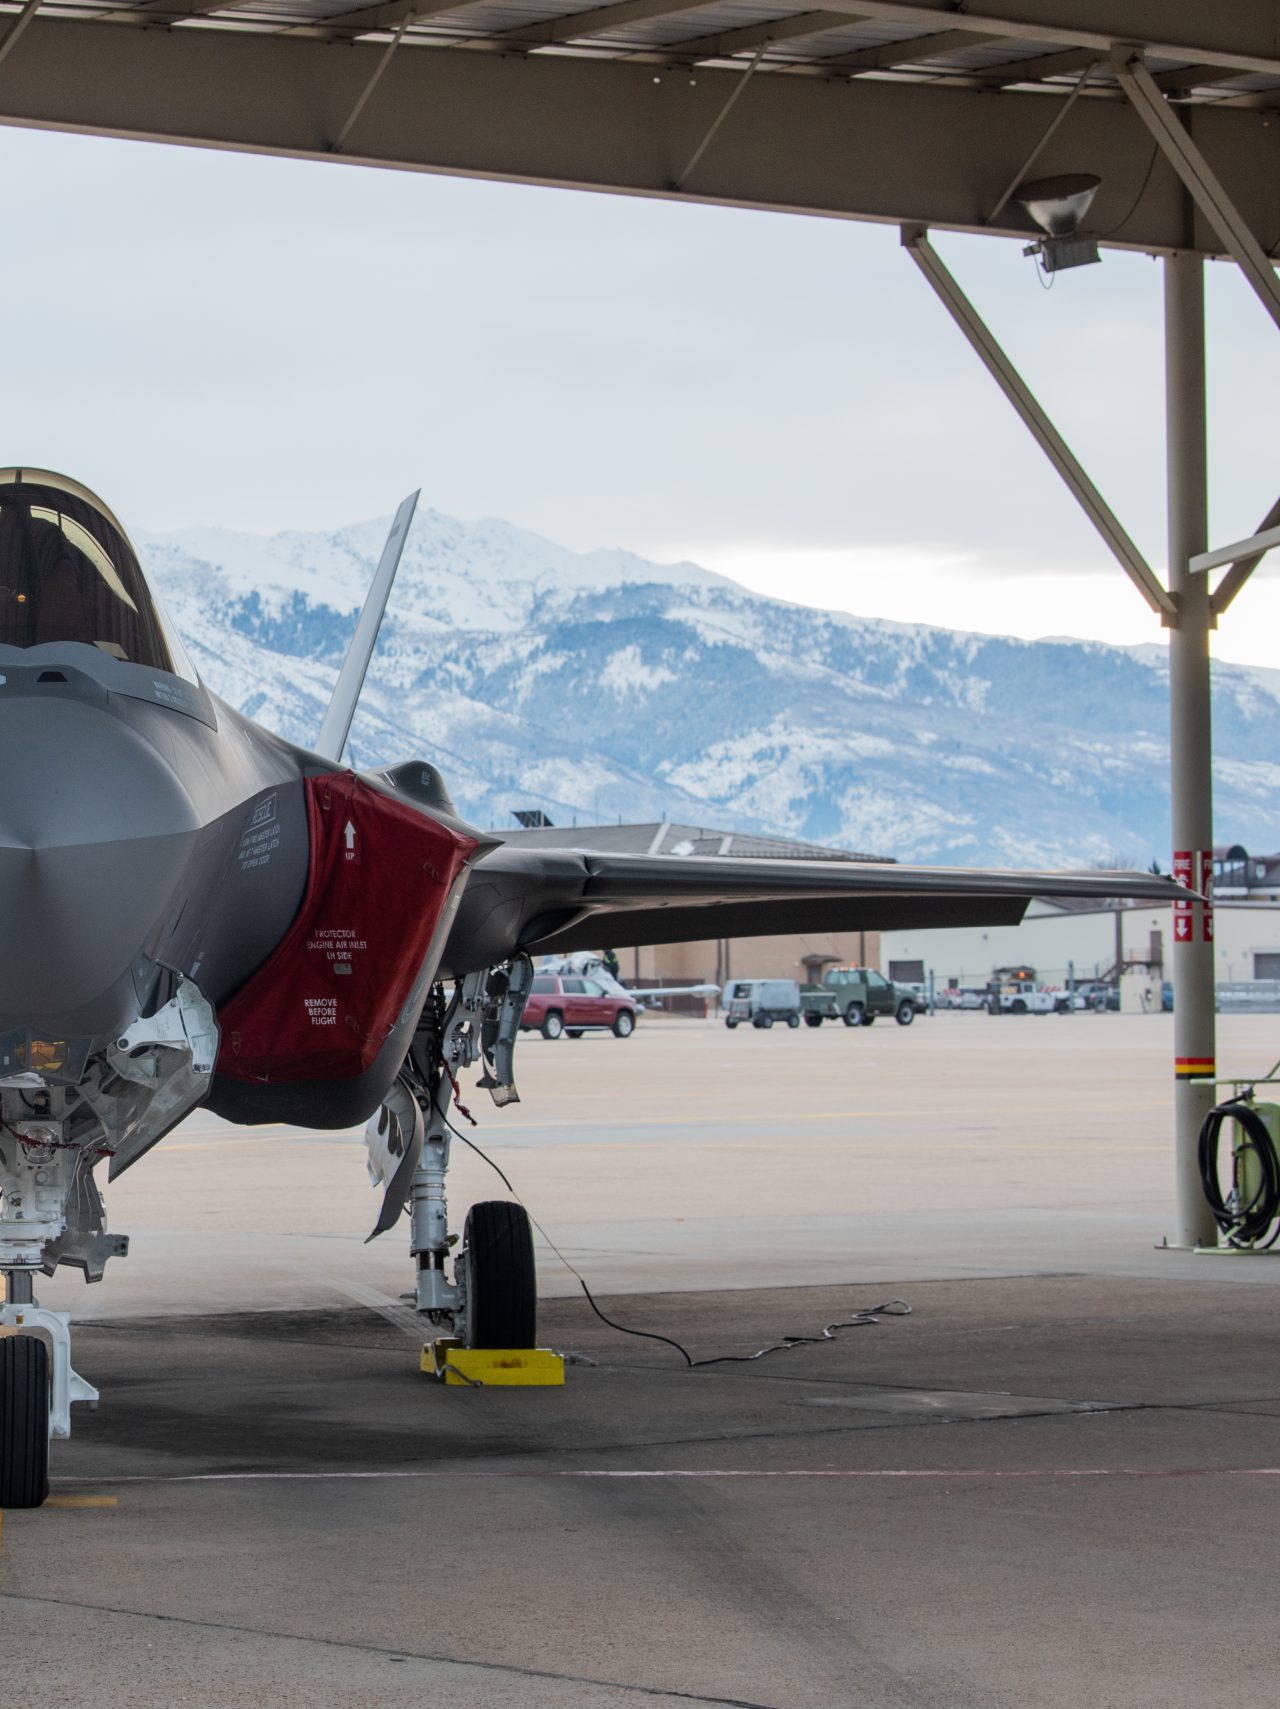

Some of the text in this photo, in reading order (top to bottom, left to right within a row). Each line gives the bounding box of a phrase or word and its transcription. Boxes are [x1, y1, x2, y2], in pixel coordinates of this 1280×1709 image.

[345, 852, 355, 860] UP
[1174, 859, 1191, 870] FIRE
[315, 929, 356, 938] PROTECTOR
[308, 941, 367, 949] ENGINE AIR INLET
[327, 952, 352, 960] LH SIDE
[304, 999, 337, 1007] REMOVE
[308, 1008, 337, 1016] BEFORE
[312, 1017, 337, 1025] FLIGHT
